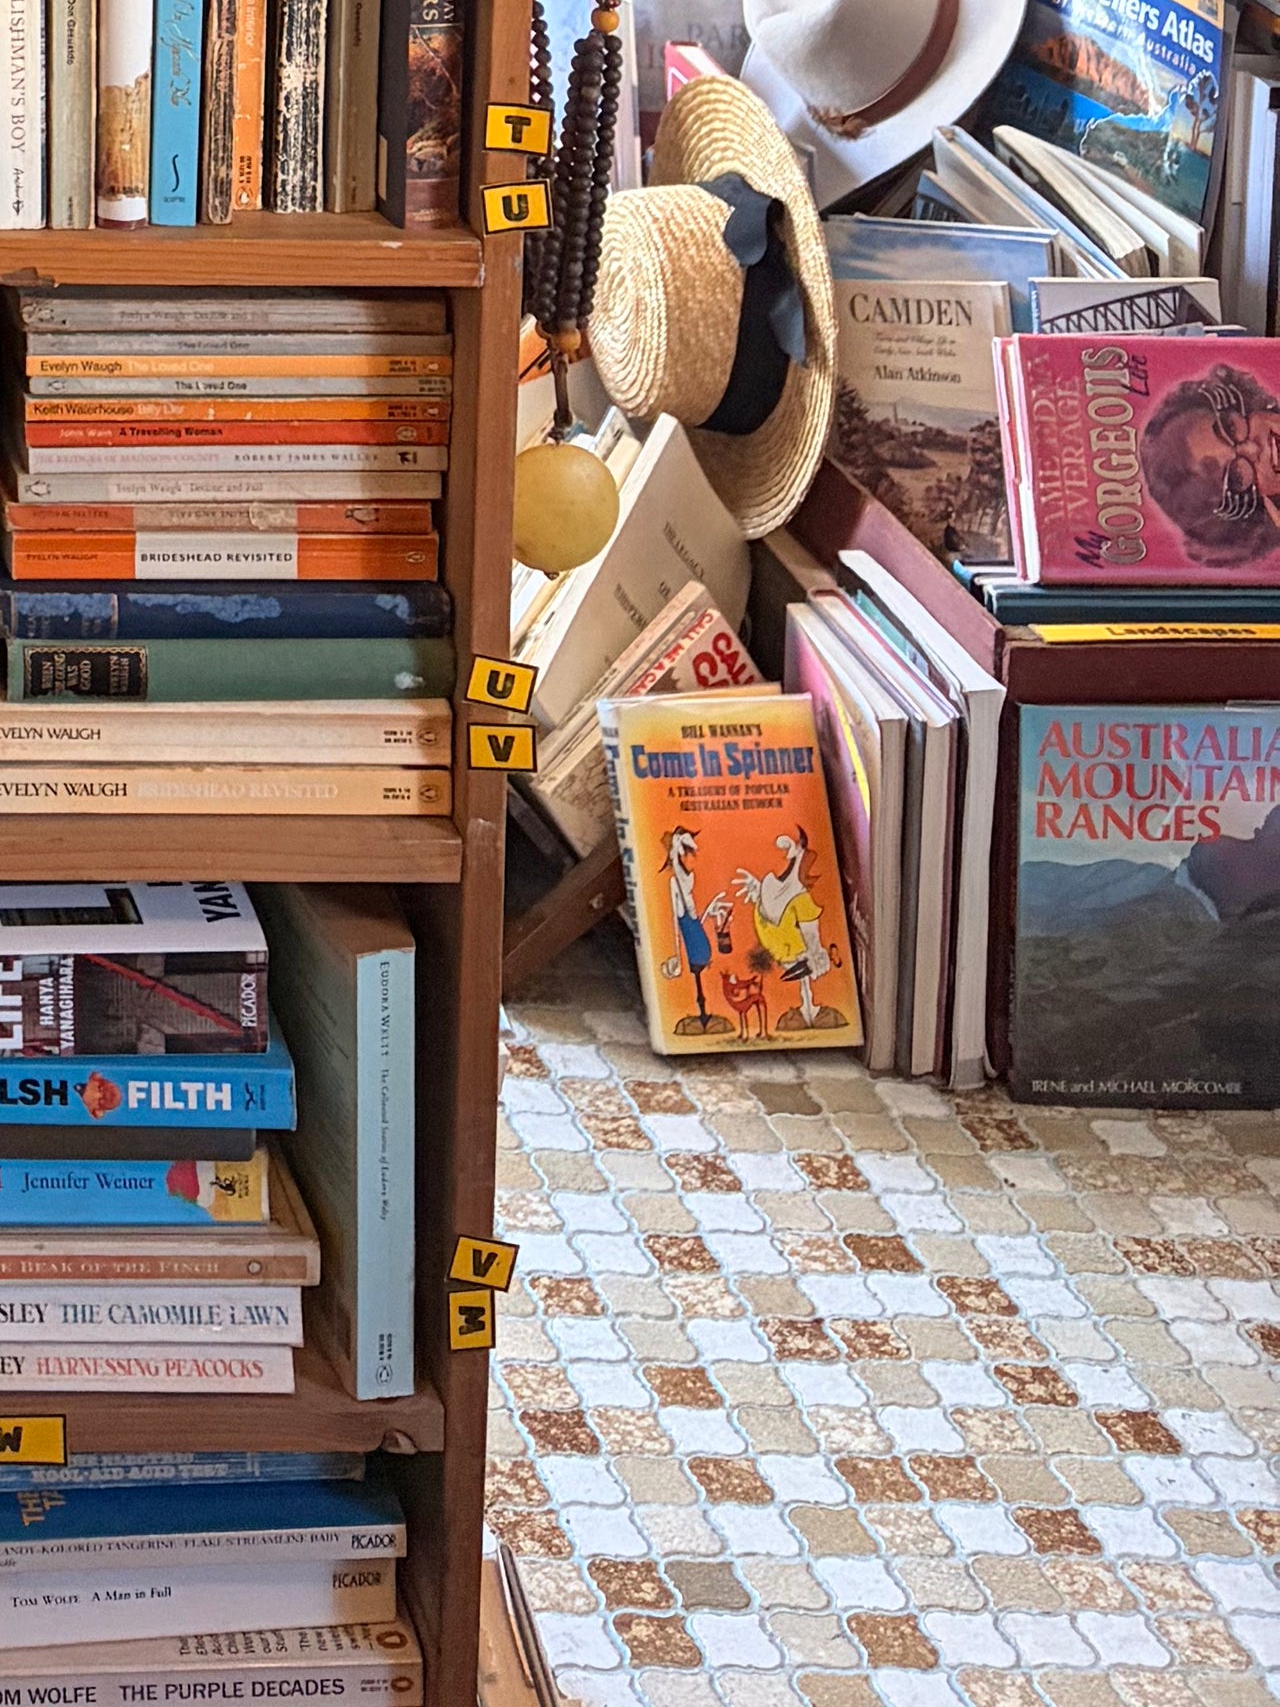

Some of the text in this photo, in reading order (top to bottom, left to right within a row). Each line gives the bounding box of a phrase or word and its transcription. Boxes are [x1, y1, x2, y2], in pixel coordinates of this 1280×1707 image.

[1161, 12, 1214, 64] Atlas
[504, 116, 530, 143] T
[501, 195, 532, 221] U
[849, 293, 972, 328] CAMDEN
[874, 364, 962, 384] Alan Atkinson
[141, 550, 293, 565] BRIDESHEAD REVISITED
[1106, 626, 1256, 636] Landscapes
[487, 670, 514, 699] U
[488, 734, 515, 764] V
[724, 743, 814, 779] Spinner
[1035, 801, 1221, 843] RANGES
[126, 1081, 233, 1112] FILTH
[471, 1248, 502, 1279] V
